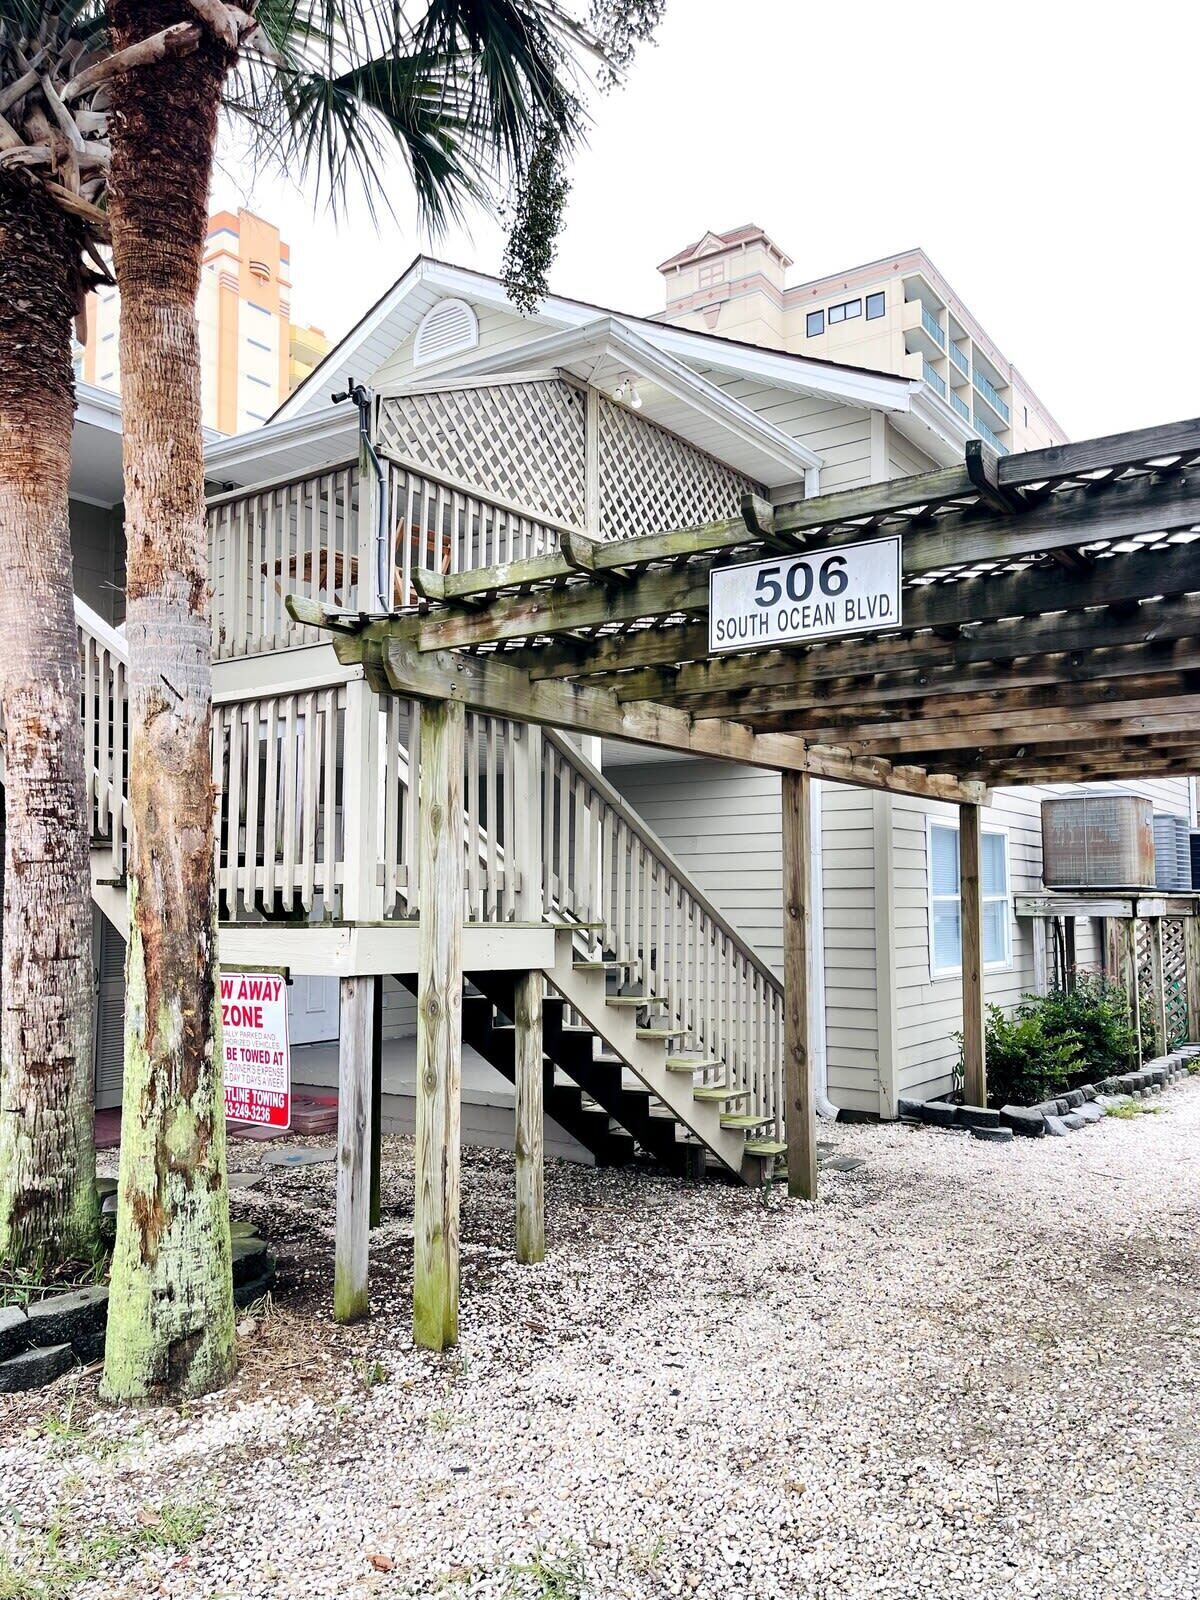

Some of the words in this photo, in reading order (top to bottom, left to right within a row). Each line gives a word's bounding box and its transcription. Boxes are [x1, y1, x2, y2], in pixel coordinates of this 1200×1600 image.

[754, 555, 848, 607] 506
[716, 612, 769, 640] SOUTH
[777, 601, 835, 631] OCEAN
[845, 593, 893, 622] BLVD.
[237, 980, 282, 1002] AWAY
[221, 1005, 264, 1028] ZONE
[240, 1031, 262, 1040] PARKED
[263, 1033, 276, 1041] AND
[251, 1040, 280, 1050] VEHICLES
[226, 1047, 238, 1061] BE
[240, 1047, 270, 1064] TOWED
[273, 1051, 284, 1066] AT
[229, 1073, 240, 1082] DAY
[246, 1075, 261, 1085] DAYS
[267, 1077, 285, 1089] WEEK
[256, 1065, 285, 1079] EXPENSE
[252, 1090, 285, 1109] TOWING
